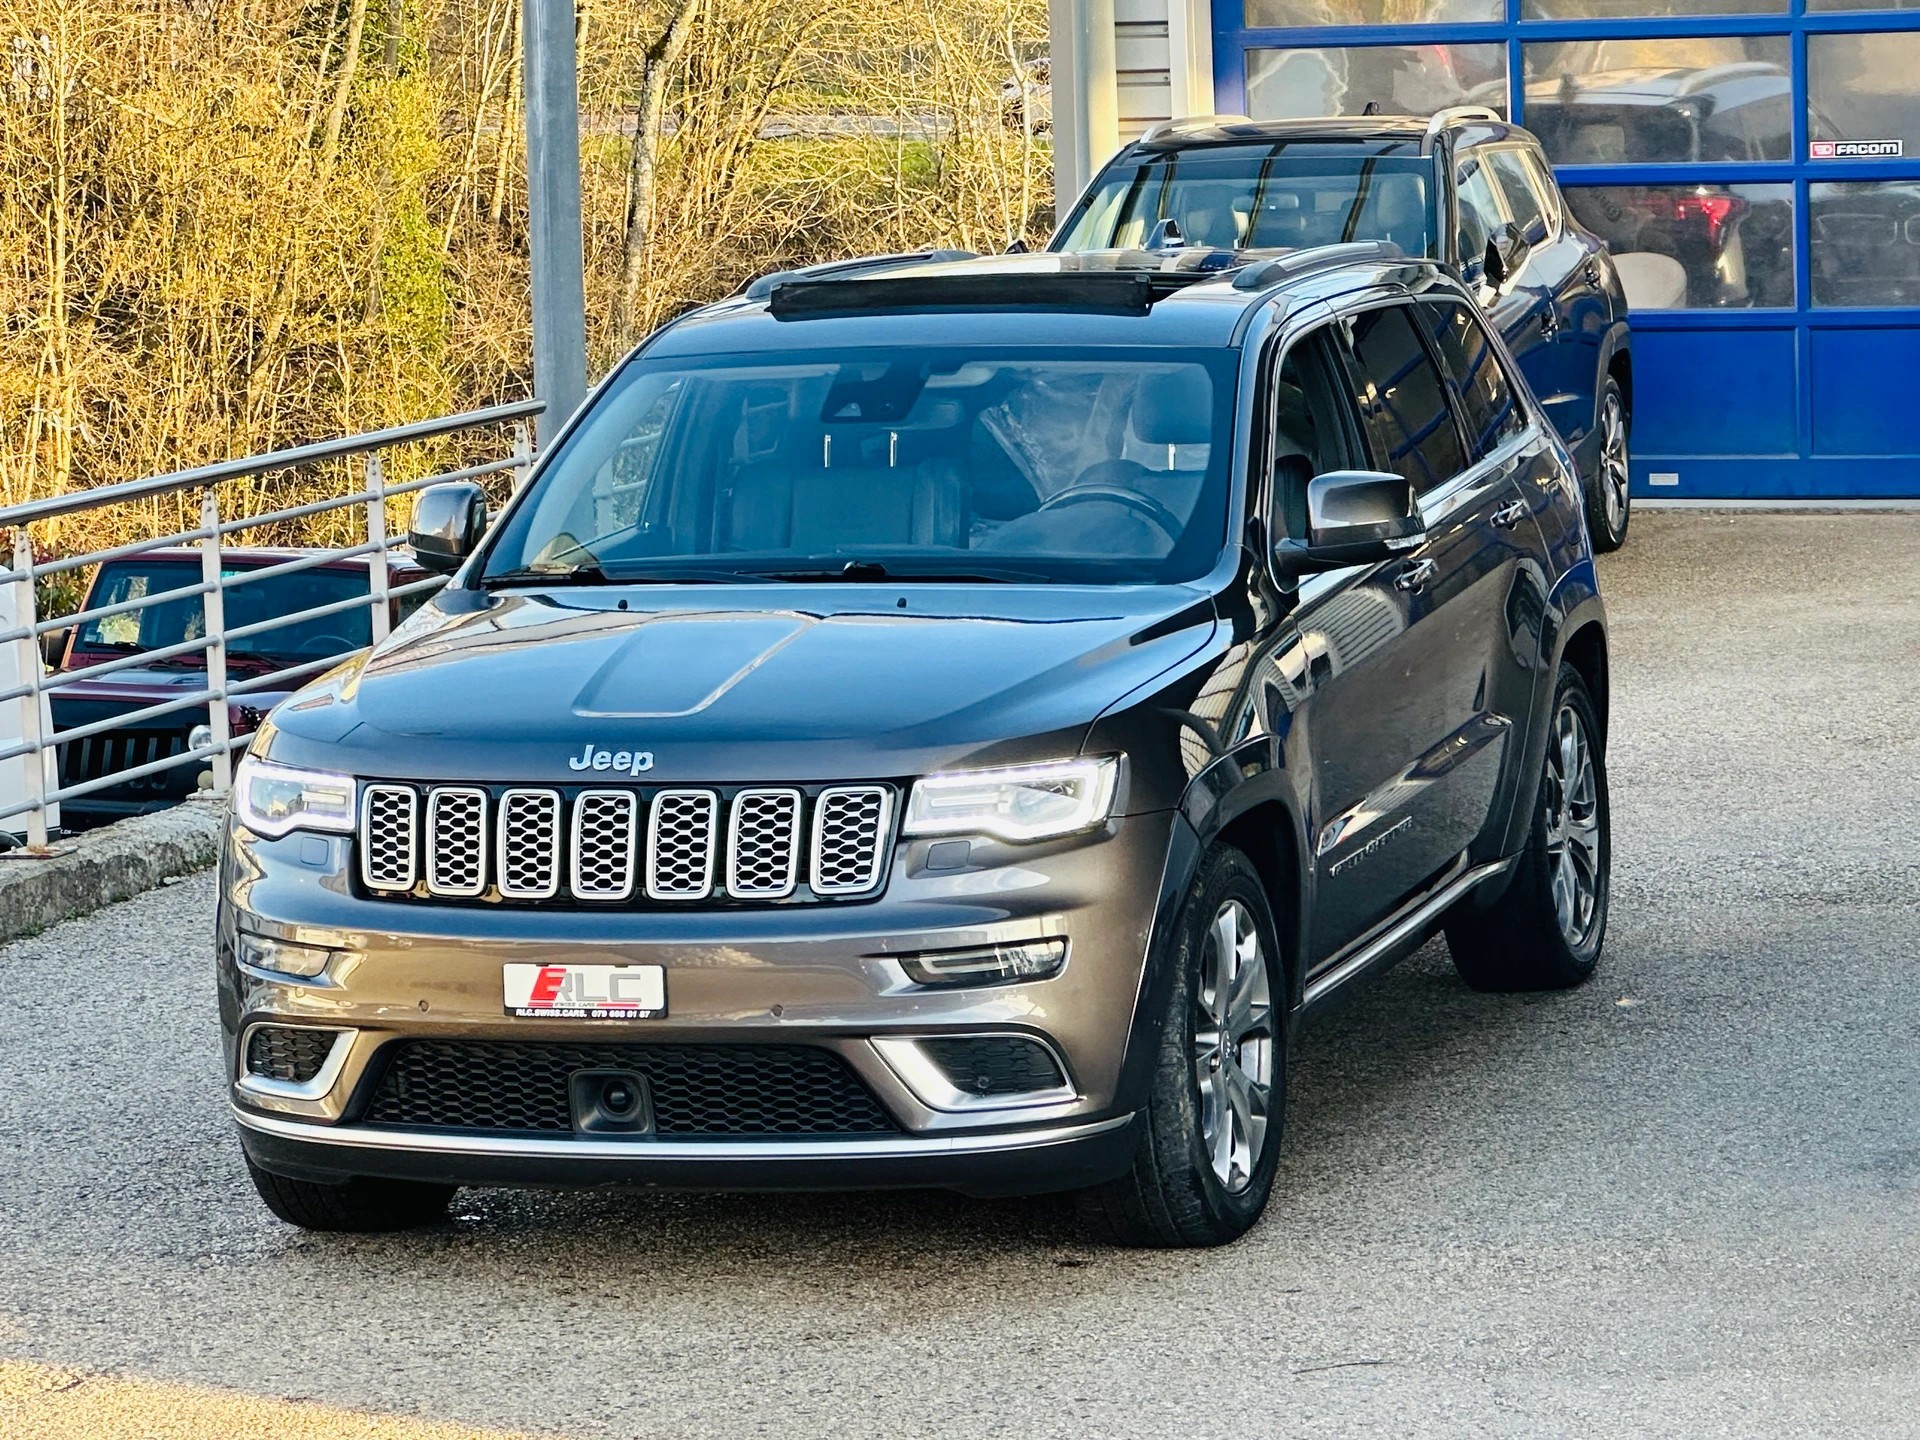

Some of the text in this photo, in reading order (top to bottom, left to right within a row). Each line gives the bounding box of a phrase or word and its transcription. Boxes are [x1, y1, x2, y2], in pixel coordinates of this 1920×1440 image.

[1836, 143, 1898, 155] FACOM
[569, 744, 654, 777] Jeep
[591, 1009, 608, 1018] 079
